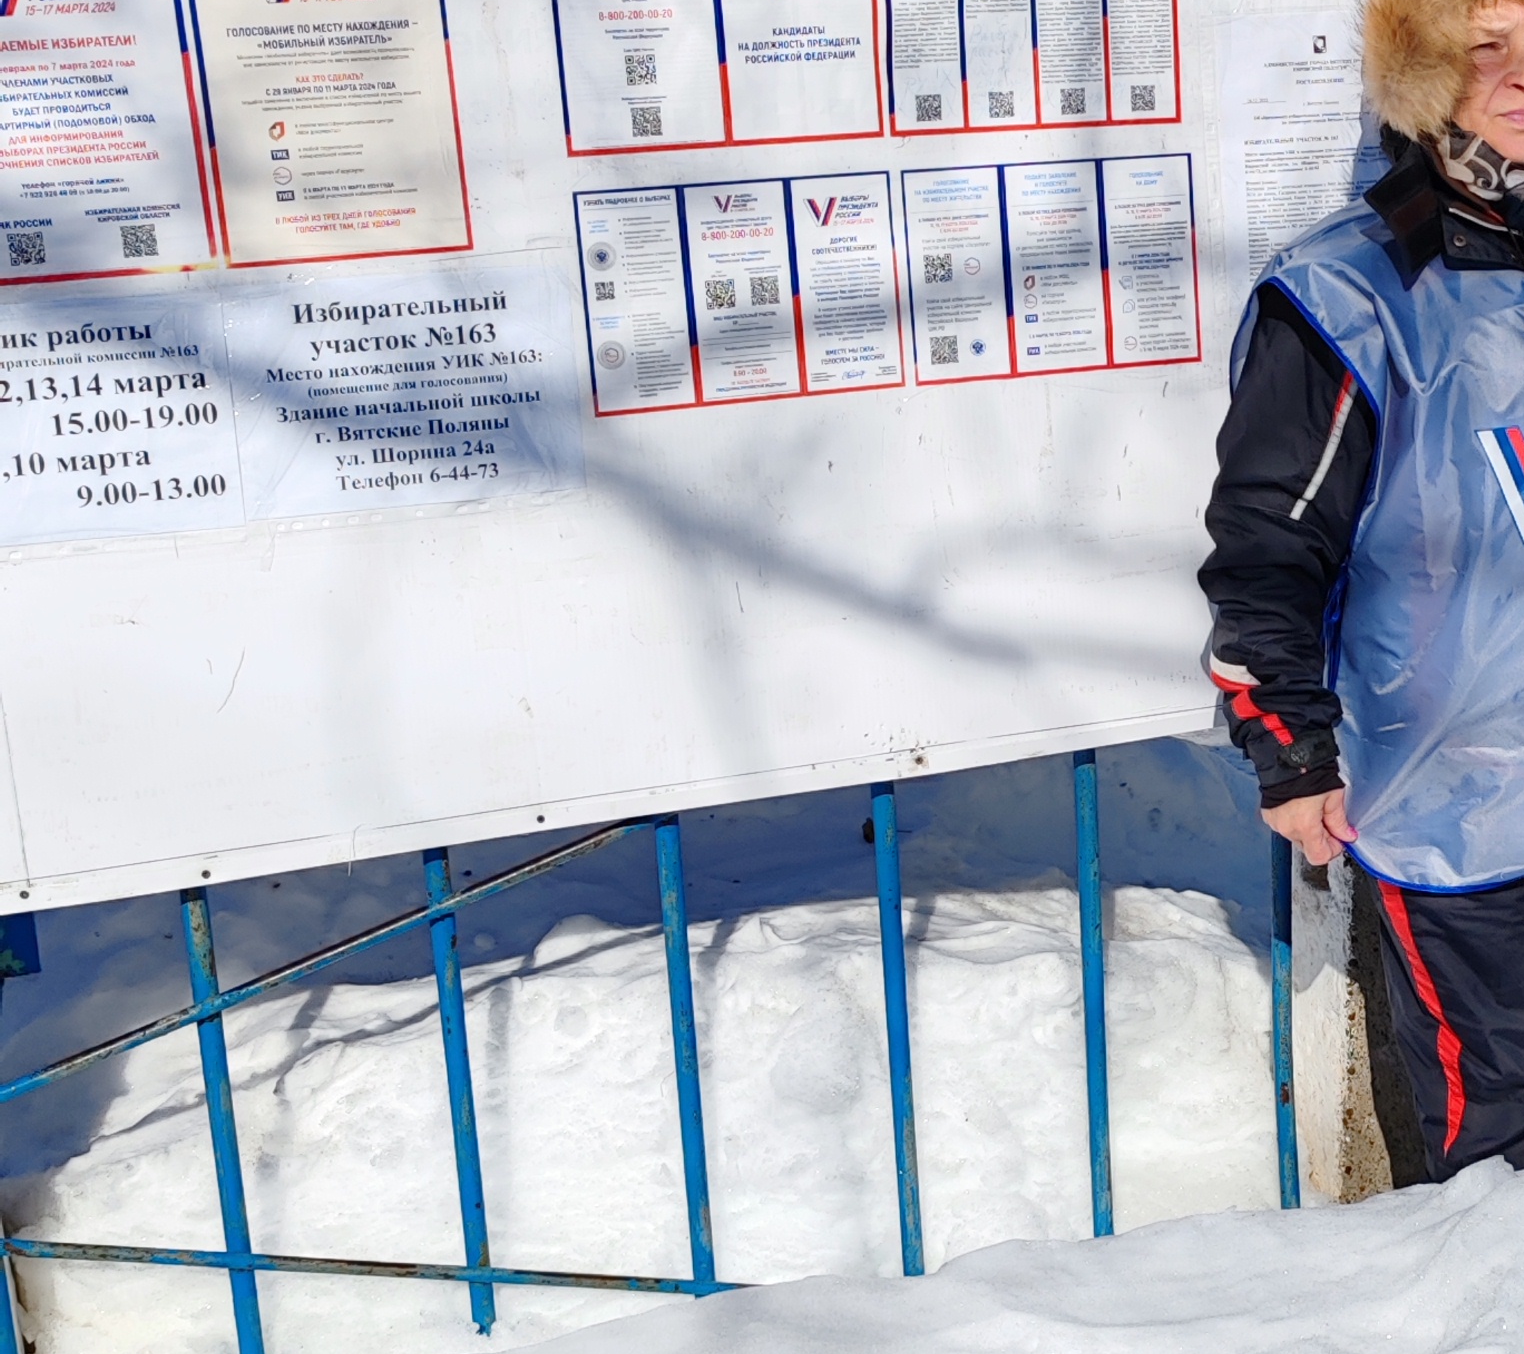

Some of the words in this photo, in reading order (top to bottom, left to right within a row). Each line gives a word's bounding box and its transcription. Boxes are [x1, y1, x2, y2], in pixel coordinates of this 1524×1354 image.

[55, 3, 89, 14] МАРТА
[91, 2, 116, 13] 2024
[599, 9, 673, 21] 8-800-200-00-20
[226, 24, 295, 38] ГОЛОСОВАНИЕ
[297, 23, 310, 34] ПО
[312, 22, 343, 33] МЕСТУ
[345, 19, 409, 32] НАХОЖДЕНИЯ
[772, 26, 825, 37] КАНДИДАТЫ
[51, 35, 137, 49] ИЗБИРАТЕЛИ!
[257, 35, 325, 50] «МОБИЛЬНЫЙ
[328, 35, 393, 46] ИЗБИРАТЕЛЬ»
[738, 43, 750, 51] НА
[752, 39, 805, 52] ДОЛЖНОСТЬ
[807, 37, 861, 48] ПРЕЗИДЕНТА
[745, 51, 802, 64] РОССИЙСКОЙ
[804, 50, 856, 61] ФЕДЕРАЦИИ
[0, 65, 36, 74] евраля
[51, 63, 56, 71] 7
[60, 61, 88, 71] марта
[90, 59, 114, 69] 2024
[115, 60, 136, 68] года
[1, 78, 48, 88] ЧЛЕНАМИ
[50, 74, 114, 85] УЧАСТКОВЫХ
[296, 75, 310, 83] КАК
[312, 74, 326, 82] ЭТО
[74, 86, 129, 98] КОМИССИЙ
[333, 83, 358, 92] МАРТА
[12, 107, 40, 117] БУДЕТ
[43, 103, 111, 115] ПРОВОДИТЬСЯ
[54, 115, 122, 129] (ПОДОМОВОЙ)
[124, 114, 156, 124] ОБХОД
[8, 136, 27, 145] ДЛЯ
[30, 130, 124, 143] ИНФОРМИРОВАНИЯ
[46, 143, 106, 155] ПРЕЗИДЕНТА
[108, 141, 146, 150] РОССИИ
[46, 156, 92, 167] СПИСКОВ
[95, 151, 160, 164] ИЗБИРАТЕЛЕЙ
[13, 218, 53, 229] РОССИИ
[701, 227, 774, 241] 8-800-200-00-20
[292, 291, 507, 326] Избирательный
[46, 323, 152, 352] работы
[310, 334, 417, 361] участок
[425, 322, 497, 348] №163
[87, 351, 156, 364] комиссии
[160, 345, 199, 357] №163
[266, 368, 323, 384] Место
[329, 361, 436, 379] нахождения
[441, 353, 485, 370] УИК
[489, 350, 543, 366] №163:
[114, 371, 206, 398] марта
[308, 381, 390, 399] (помещение
[393, 381, 417, 392] для
[420, 371, 508, 390] голосования)
[276, 406, 349, 423] Здание
[355, 394, 464, 417] начальной
[470, 390, 541, 407] школы
[52, 402, 218, 436] 15.00-19.00
[315, 431, 331, 444] г.
[337, 425, 422, 443] Вятские
[428, 417, 510, 434] Поляны
[57, 449, 151, 476] марта
[336, 453, 365, 471] ул.
[372, 444, 457, 466] Шорина
[462, 440, 495, 456] 24а
[336, 471, 424, 491] Телефон
[429, 462, 499, 483] 6-44-73
[77, 474, 226, 508] 9.00-13.00
